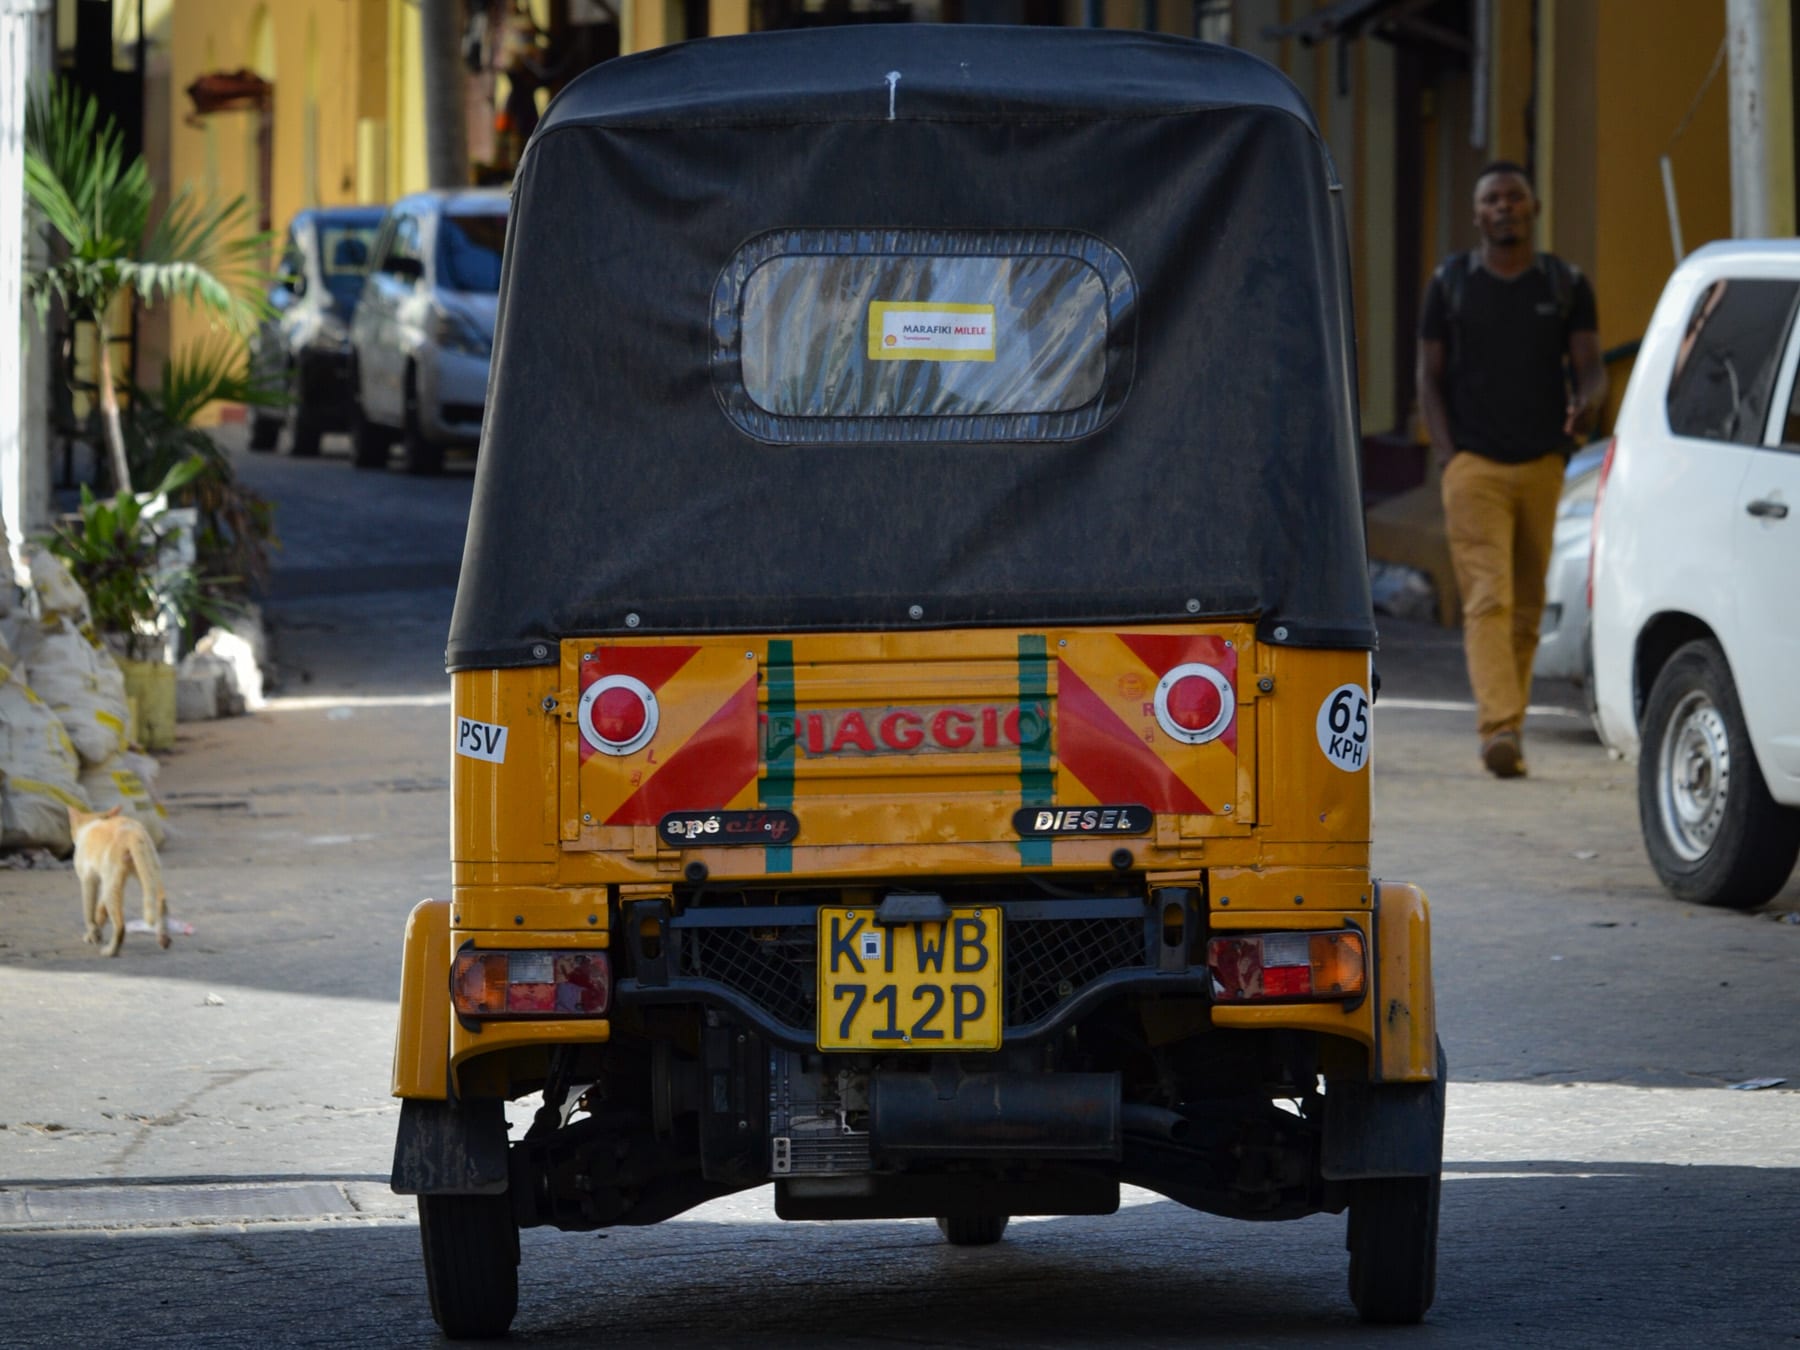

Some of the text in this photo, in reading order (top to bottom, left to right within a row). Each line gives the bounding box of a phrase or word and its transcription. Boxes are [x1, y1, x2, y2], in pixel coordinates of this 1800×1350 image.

[903, 325, 986, 335] MARAFIKI MILELE
[1329, 690, 1368, 743] 65
[460, 720, 502, 755] PSV
[1328, 734, 1362, 766] KPH
[725, 813, 789, 840] city
[1034, 810, 1132, 831] DIESEL
[830, 917, 989, 973] KTWB
[834, 983, 986, 1039] 712P
